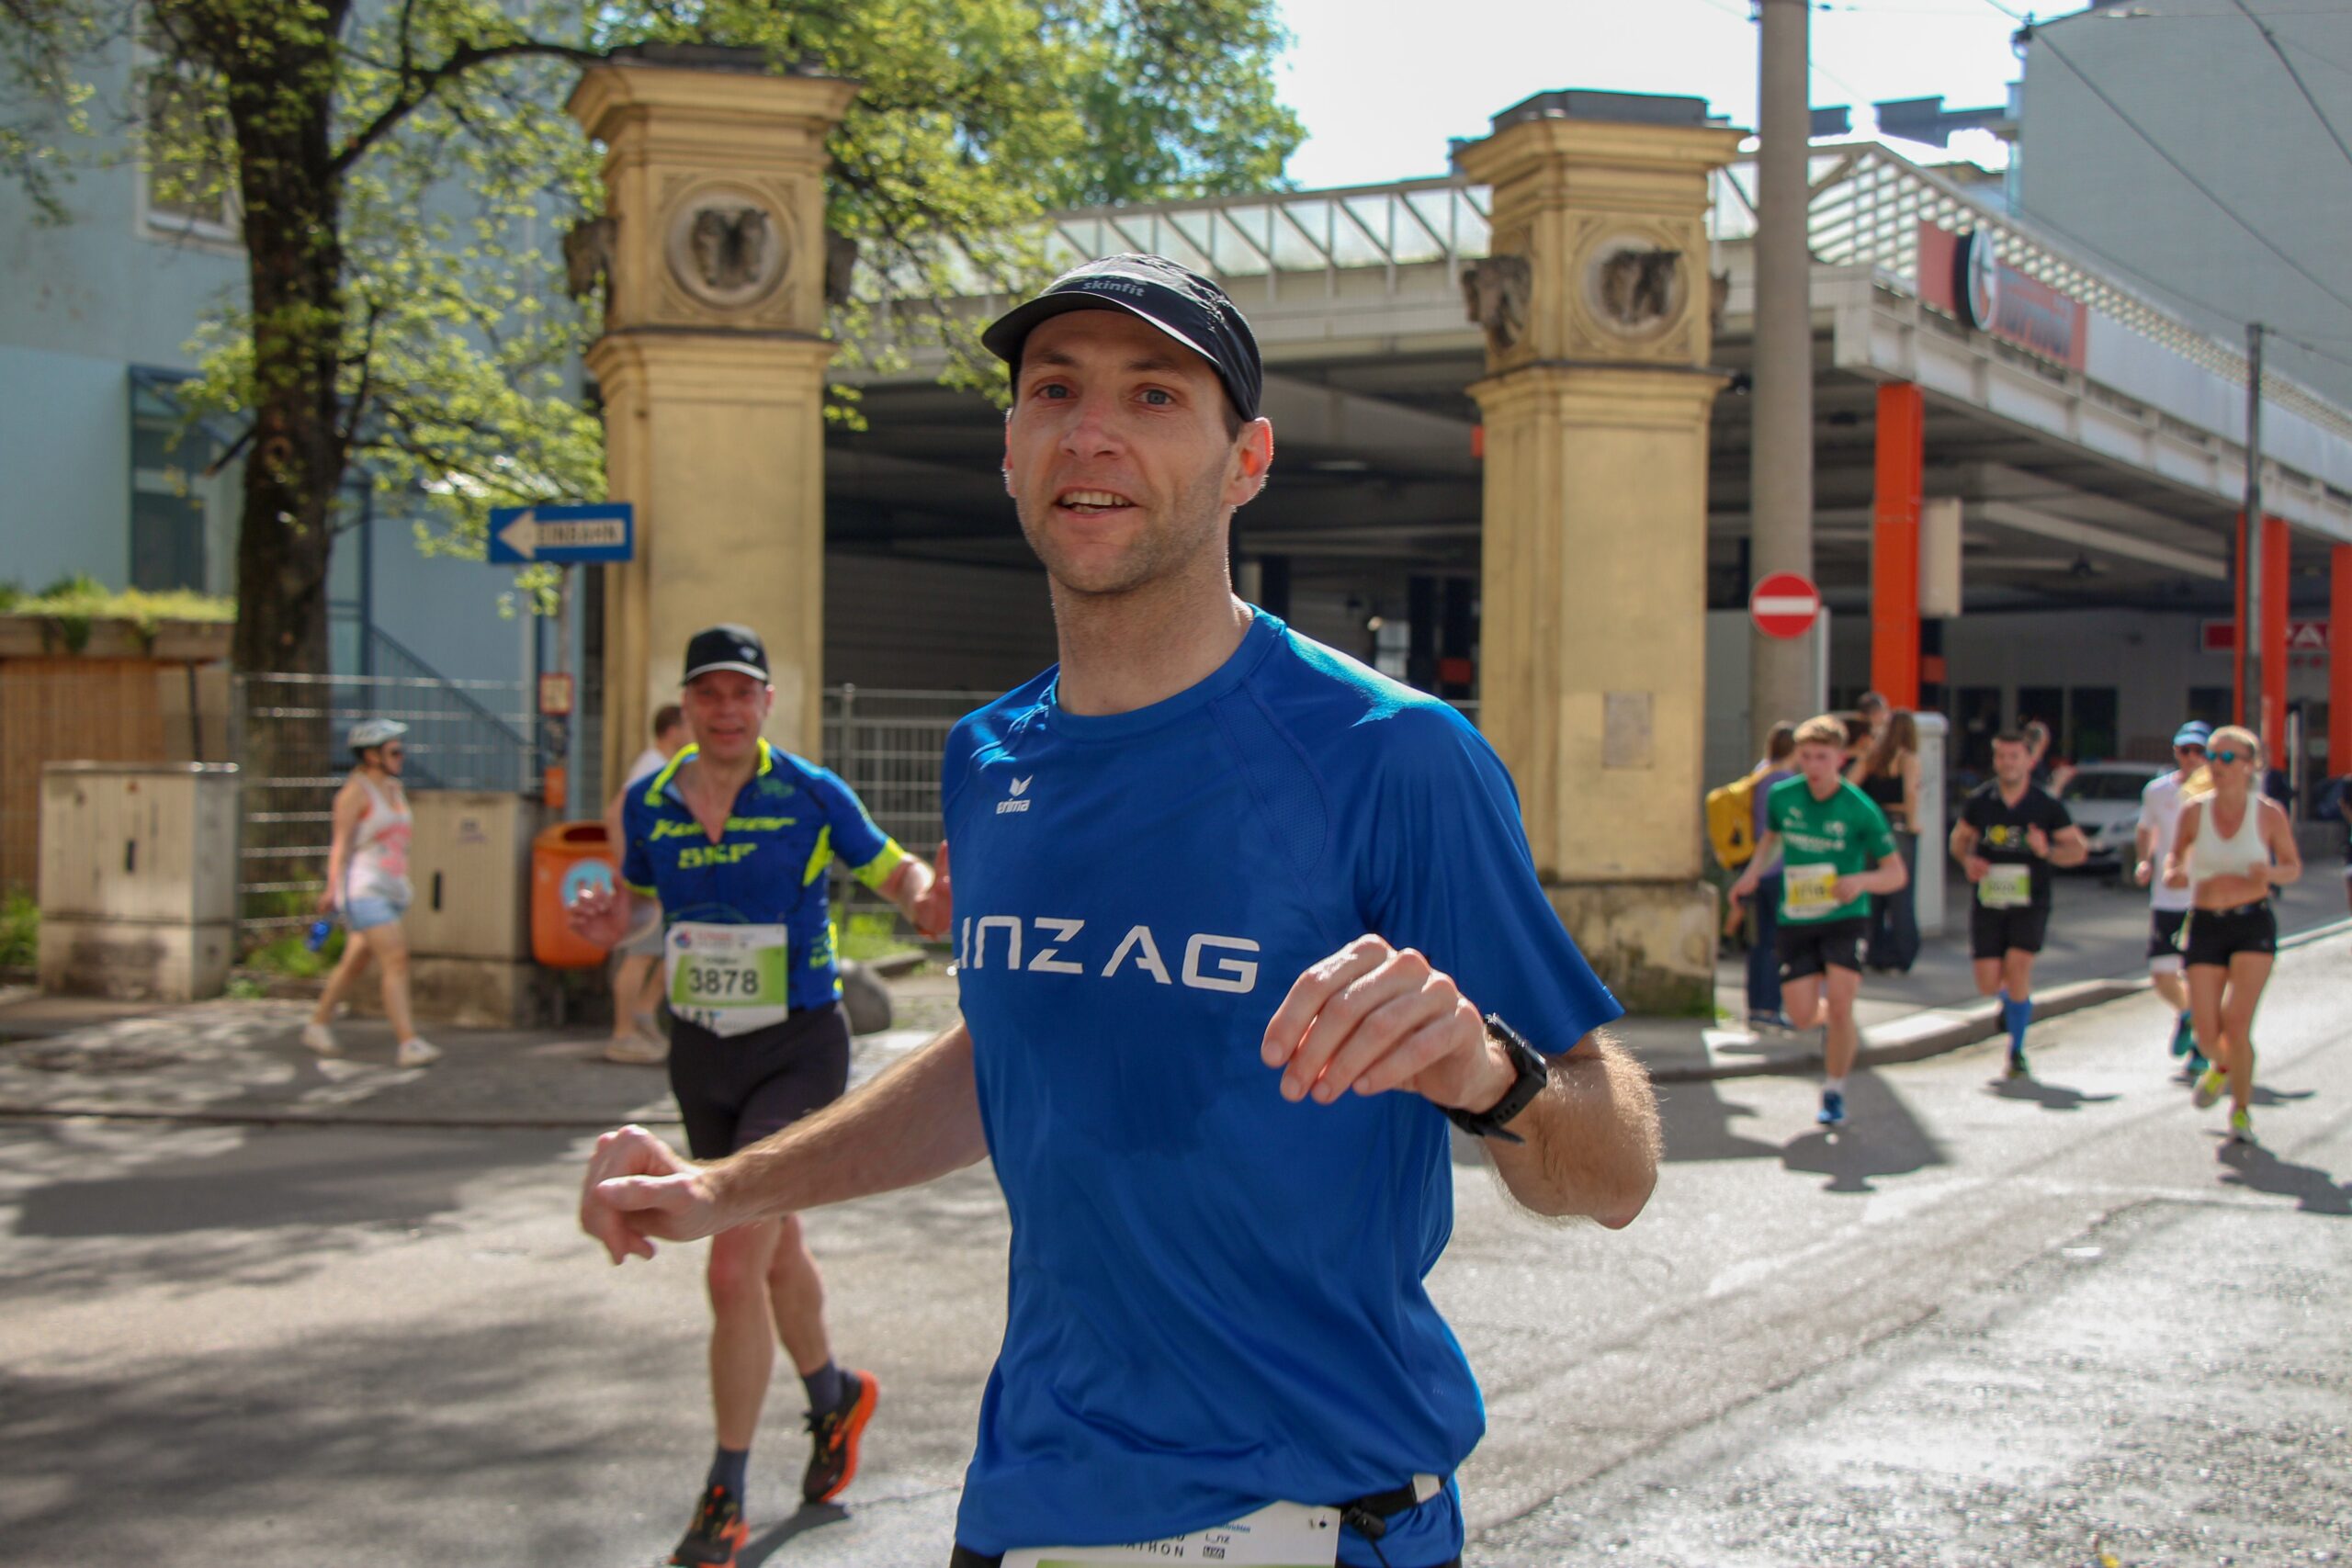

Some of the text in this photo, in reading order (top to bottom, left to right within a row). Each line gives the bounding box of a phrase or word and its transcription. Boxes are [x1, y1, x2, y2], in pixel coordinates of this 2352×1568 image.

[1082, 280, 1146, 297] skinfit
[996, 797, 1031, 815] erima
[956, 916, 1261, 994] INZ AG
[688, 966, 759, 996] 3878
[1119, 1540, 1185, 1558] ATHON
